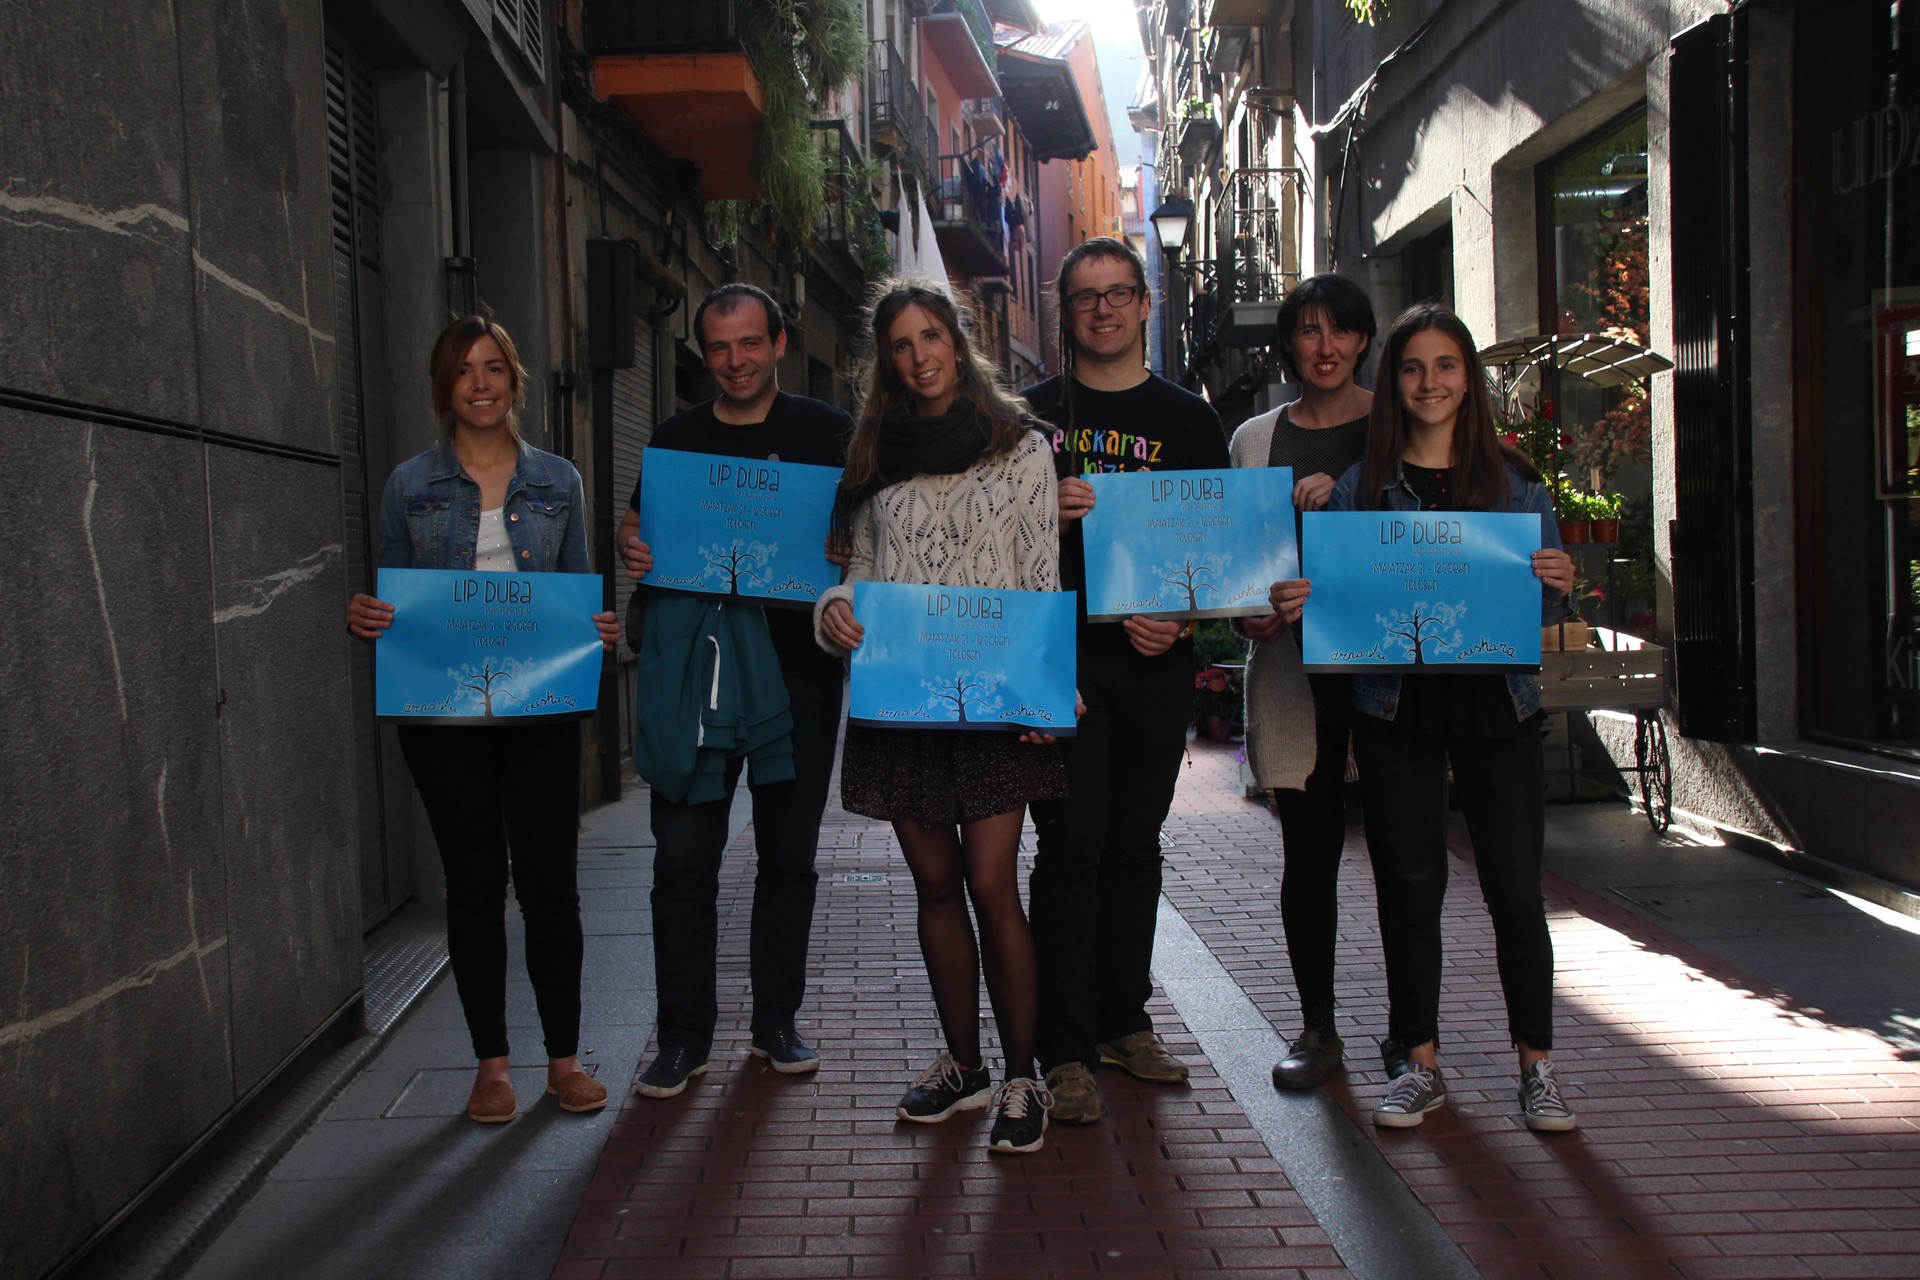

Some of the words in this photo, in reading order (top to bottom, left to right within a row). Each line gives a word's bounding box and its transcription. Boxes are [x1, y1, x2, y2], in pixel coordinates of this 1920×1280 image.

[1829, 103, 1920, 196] UD
[1053, 428, 1163, 463] euskaraz
[708, 464, 731, 486] LIP
[1152, 480, 1174, 502] LIP
[1380, 520, 1406, 545] LIP
[454, 580, 478, 602] LIP
[927, 594, 951, 616] LIP
